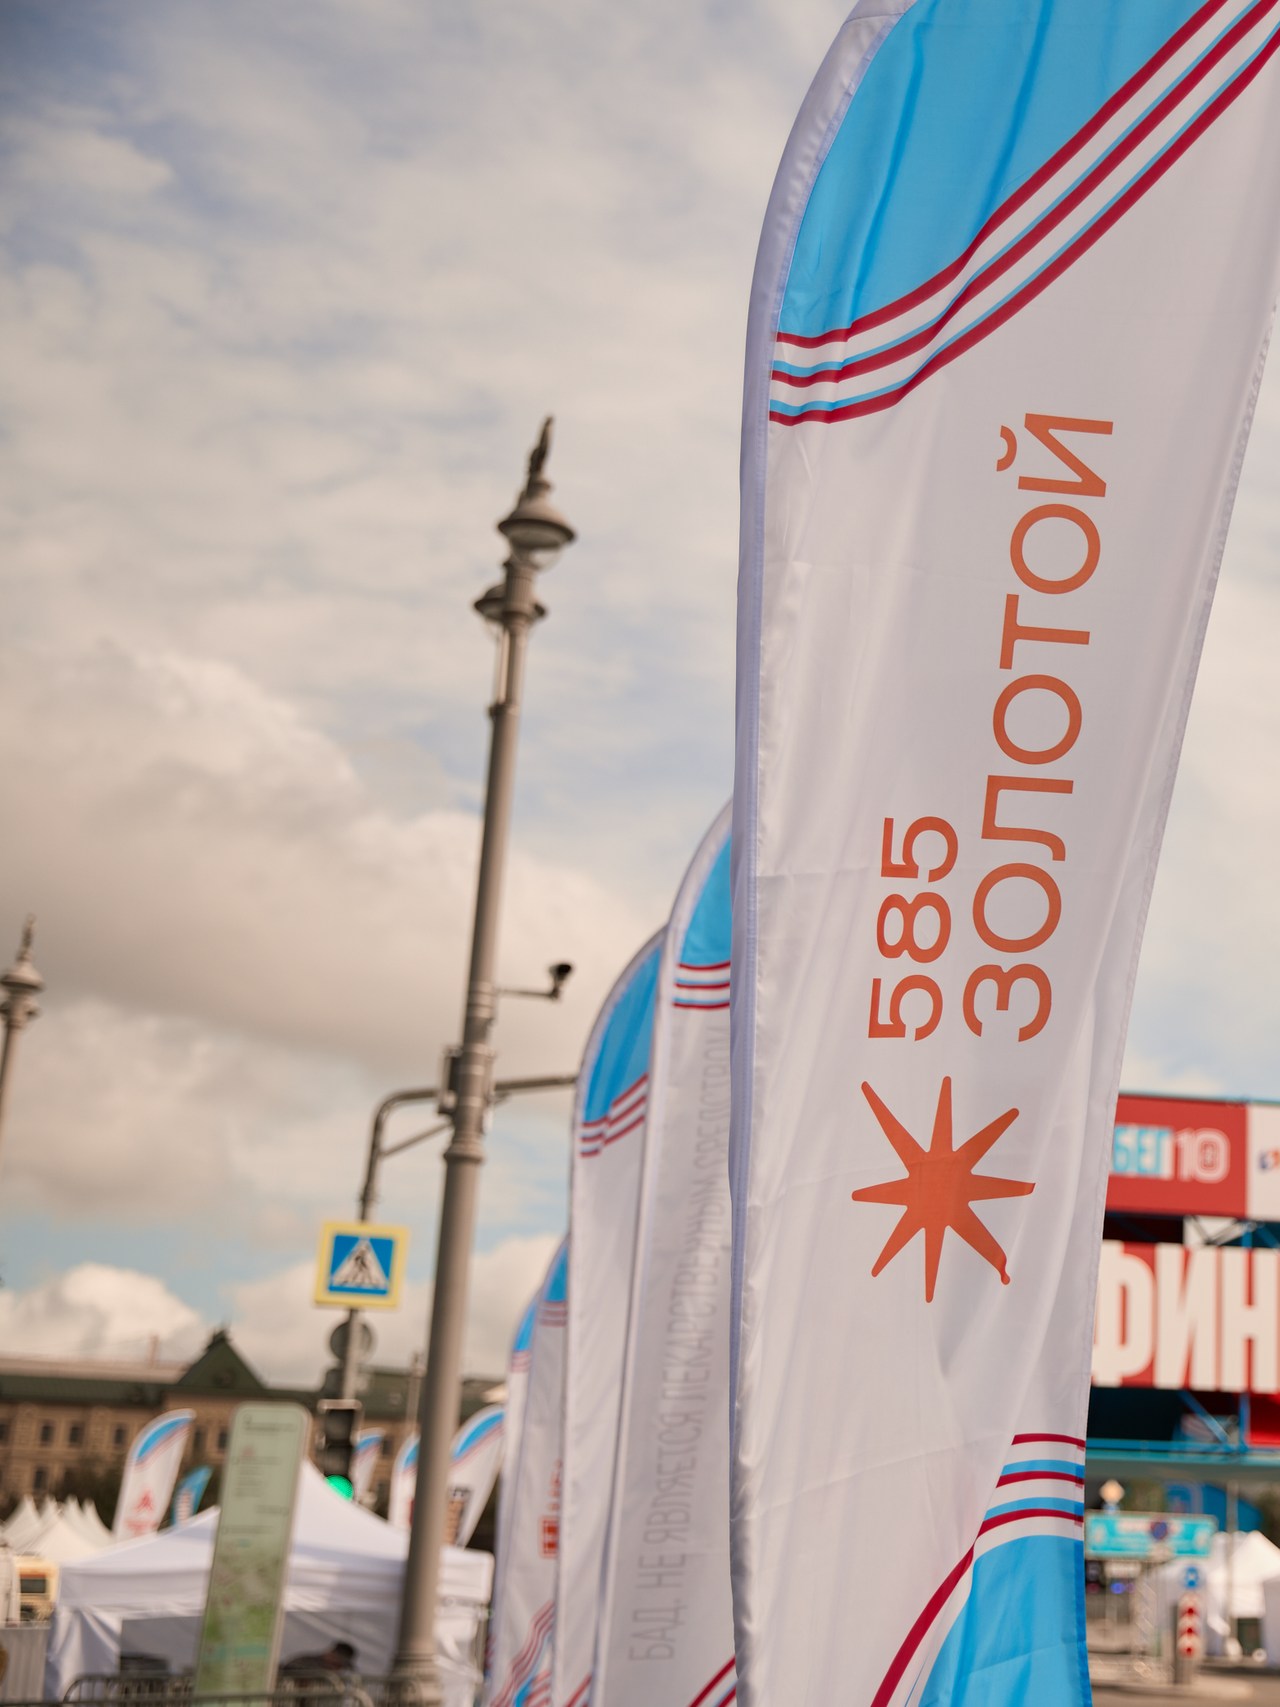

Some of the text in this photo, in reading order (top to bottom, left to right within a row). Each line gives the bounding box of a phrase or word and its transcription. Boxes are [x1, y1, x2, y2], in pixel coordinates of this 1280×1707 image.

[962, 412, 1114, 1043] ЗОЛОТОЙ
[867, 815, 958, 1043] 585
[643, 1409, 704, 1546] ЯВЛЯЕТСЯ
[635, 1553, 686, 1590] НЕ
